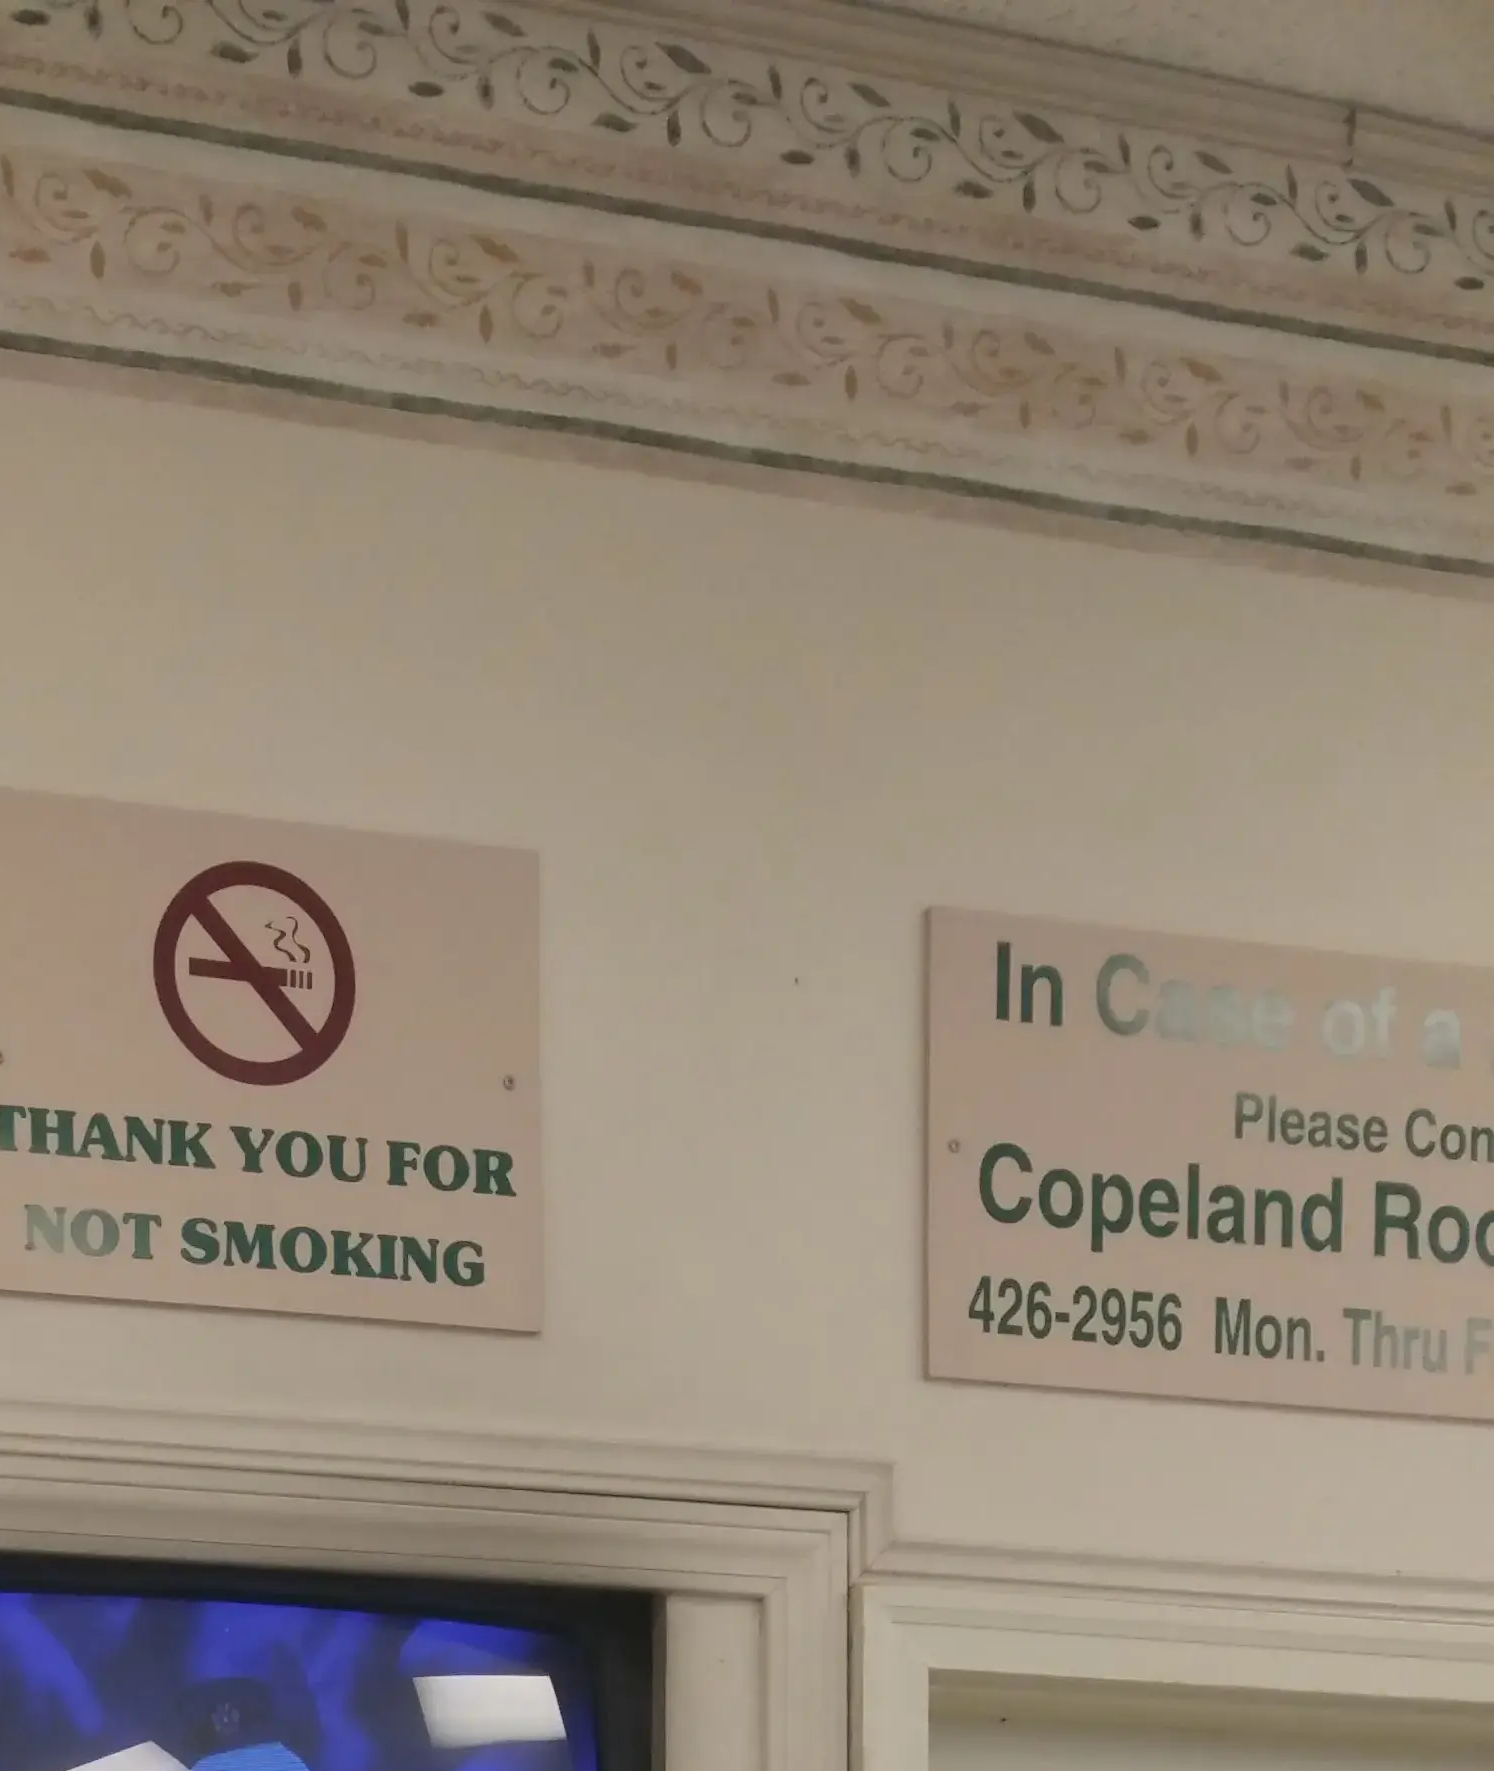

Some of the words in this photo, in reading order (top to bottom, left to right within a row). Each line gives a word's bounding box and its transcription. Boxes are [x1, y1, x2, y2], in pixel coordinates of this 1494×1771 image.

[996, 942, 1063, 1026] In
[1096, 954, 1292, 1050] Case
[1323, 986, 1396, 1060] of
[1423, 1009, 1462, 1069] a
[231, 1125, 366, 1182] YOU
[386, 1140, 516, 1197] FOR
[1235, 1093, 1387, 1152] Please
[980, 1143, 1343, 1253] Copeland
[24, 1205, 162, 1260] NOT
[180, 1217, 485, 1287] SMOKING
[968, 1276, 1182, 1350] 426-2956
[1215, 1297, 1325, 1362] Mon.
[1343, 1306, 1448, 1374] Thru
